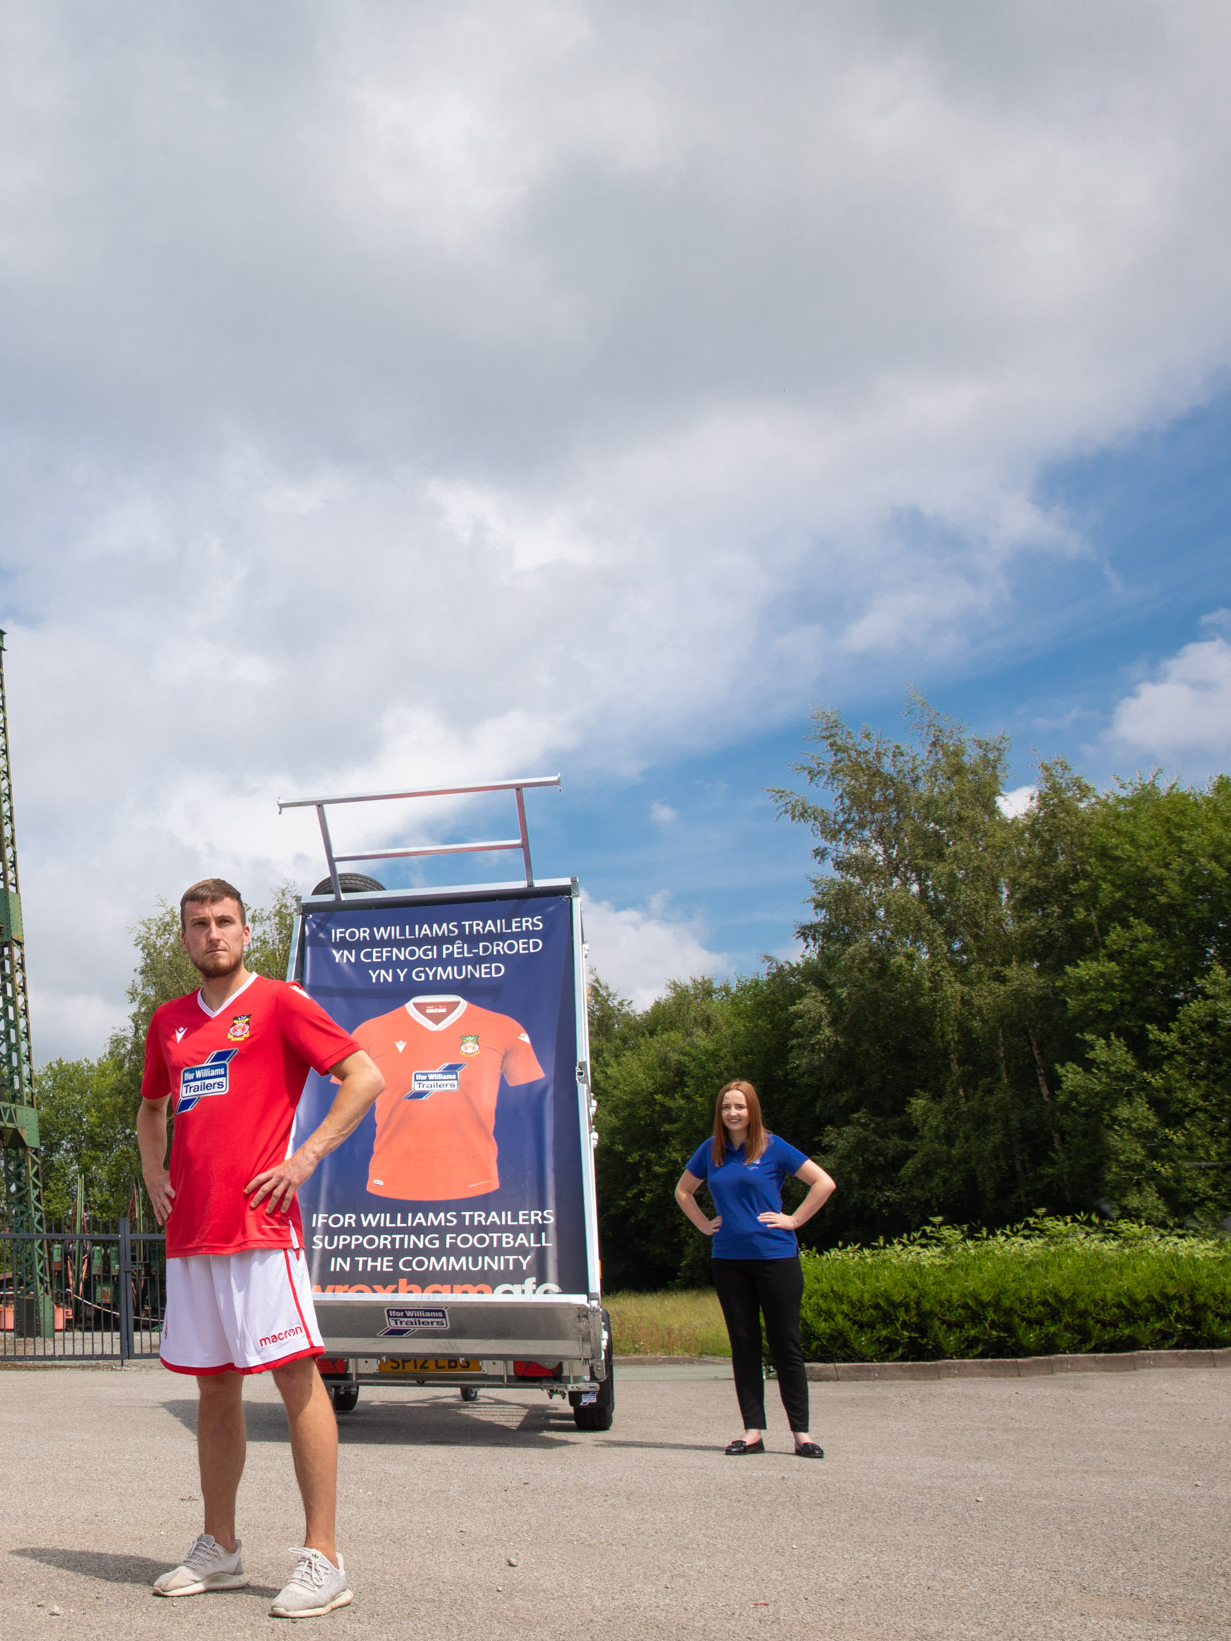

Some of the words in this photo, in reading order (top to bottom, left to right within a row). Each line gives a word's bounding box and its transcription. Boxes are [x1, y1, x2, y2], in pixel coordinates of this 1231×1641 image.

[331, 927, 370, 943] IFOR
[373, 922, 459, 940] WILLIAMS
[461, 916, 543, 935] TRAILERS
[331, 949, 356, 963] YN
[360, 945, 437, 963] CEFNOGI
[442, 938, 543, 958] PÊL-DROED
[368, 968, 393, 983] YN
[396, 968, 408, 982] Y
[412, 963, 505, 982] GYMUNED
[195, 1067, 225, 1079] Williams
[183, 1080, 224, 1094] Trailers
[416, 1081, 456, 1089] Trailers
[311, 1213, 356, 1228] IFOR
[360, 1212, 457, 1228] WILLIAMS
[461, 1209, 555, 1226] TRAILERS
[311, 1234, 440, 1250] SUPPORTING
[445, 1232, 553, 1249] FOOTBALL
[330, 1257, 351, 1272] IN
[354, 1257, 394, 1272] THE
[398, 1255, 532, 1272] COMMUNITY
[389, 1309, 404, 1317] Ifor
[405, 1309, 444, 1317] Williams
[390, 1318, 445, 1327] Trailers
[258, 1326, 303, 1347] macron
